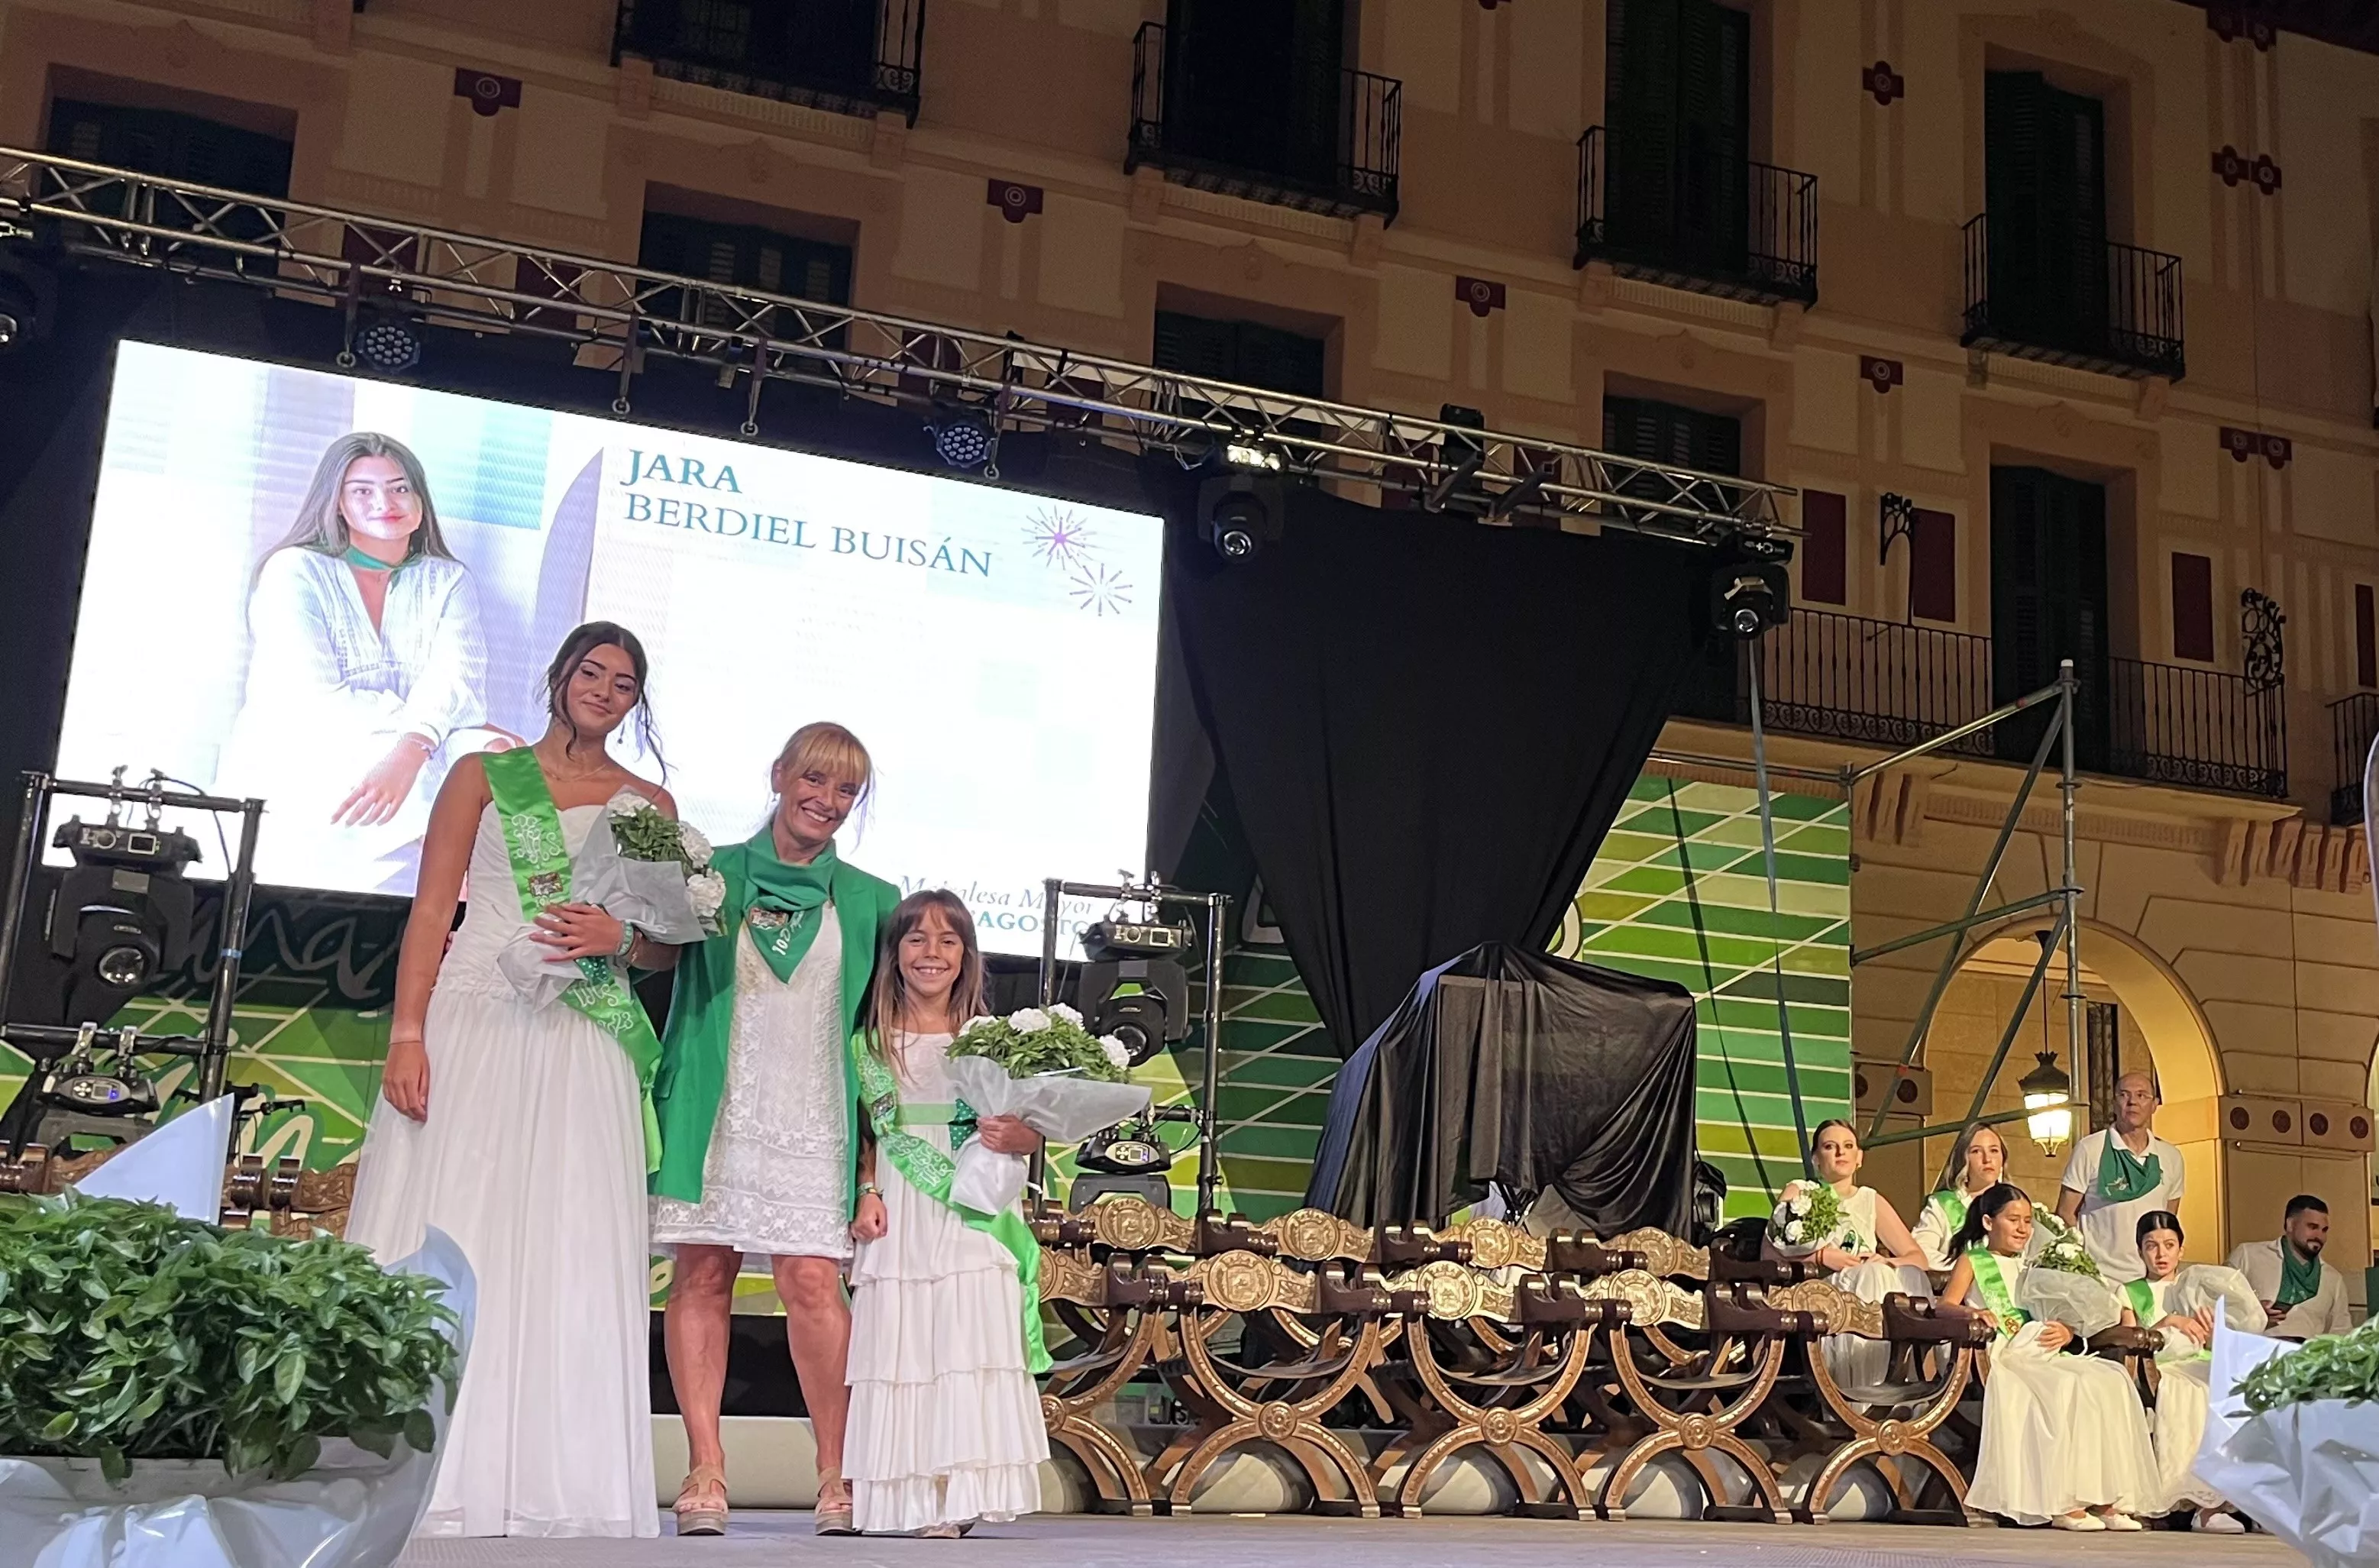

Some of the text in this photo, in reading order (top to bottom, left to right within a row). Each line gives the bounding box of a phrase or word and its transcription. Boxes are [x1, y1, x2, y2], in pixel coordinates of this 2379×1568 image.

[619, 448, 742, 493] JARA
[624, 492, 993, 577] BERDIEL BUISÁN
[1018, 888, 1094, 917] Myor
